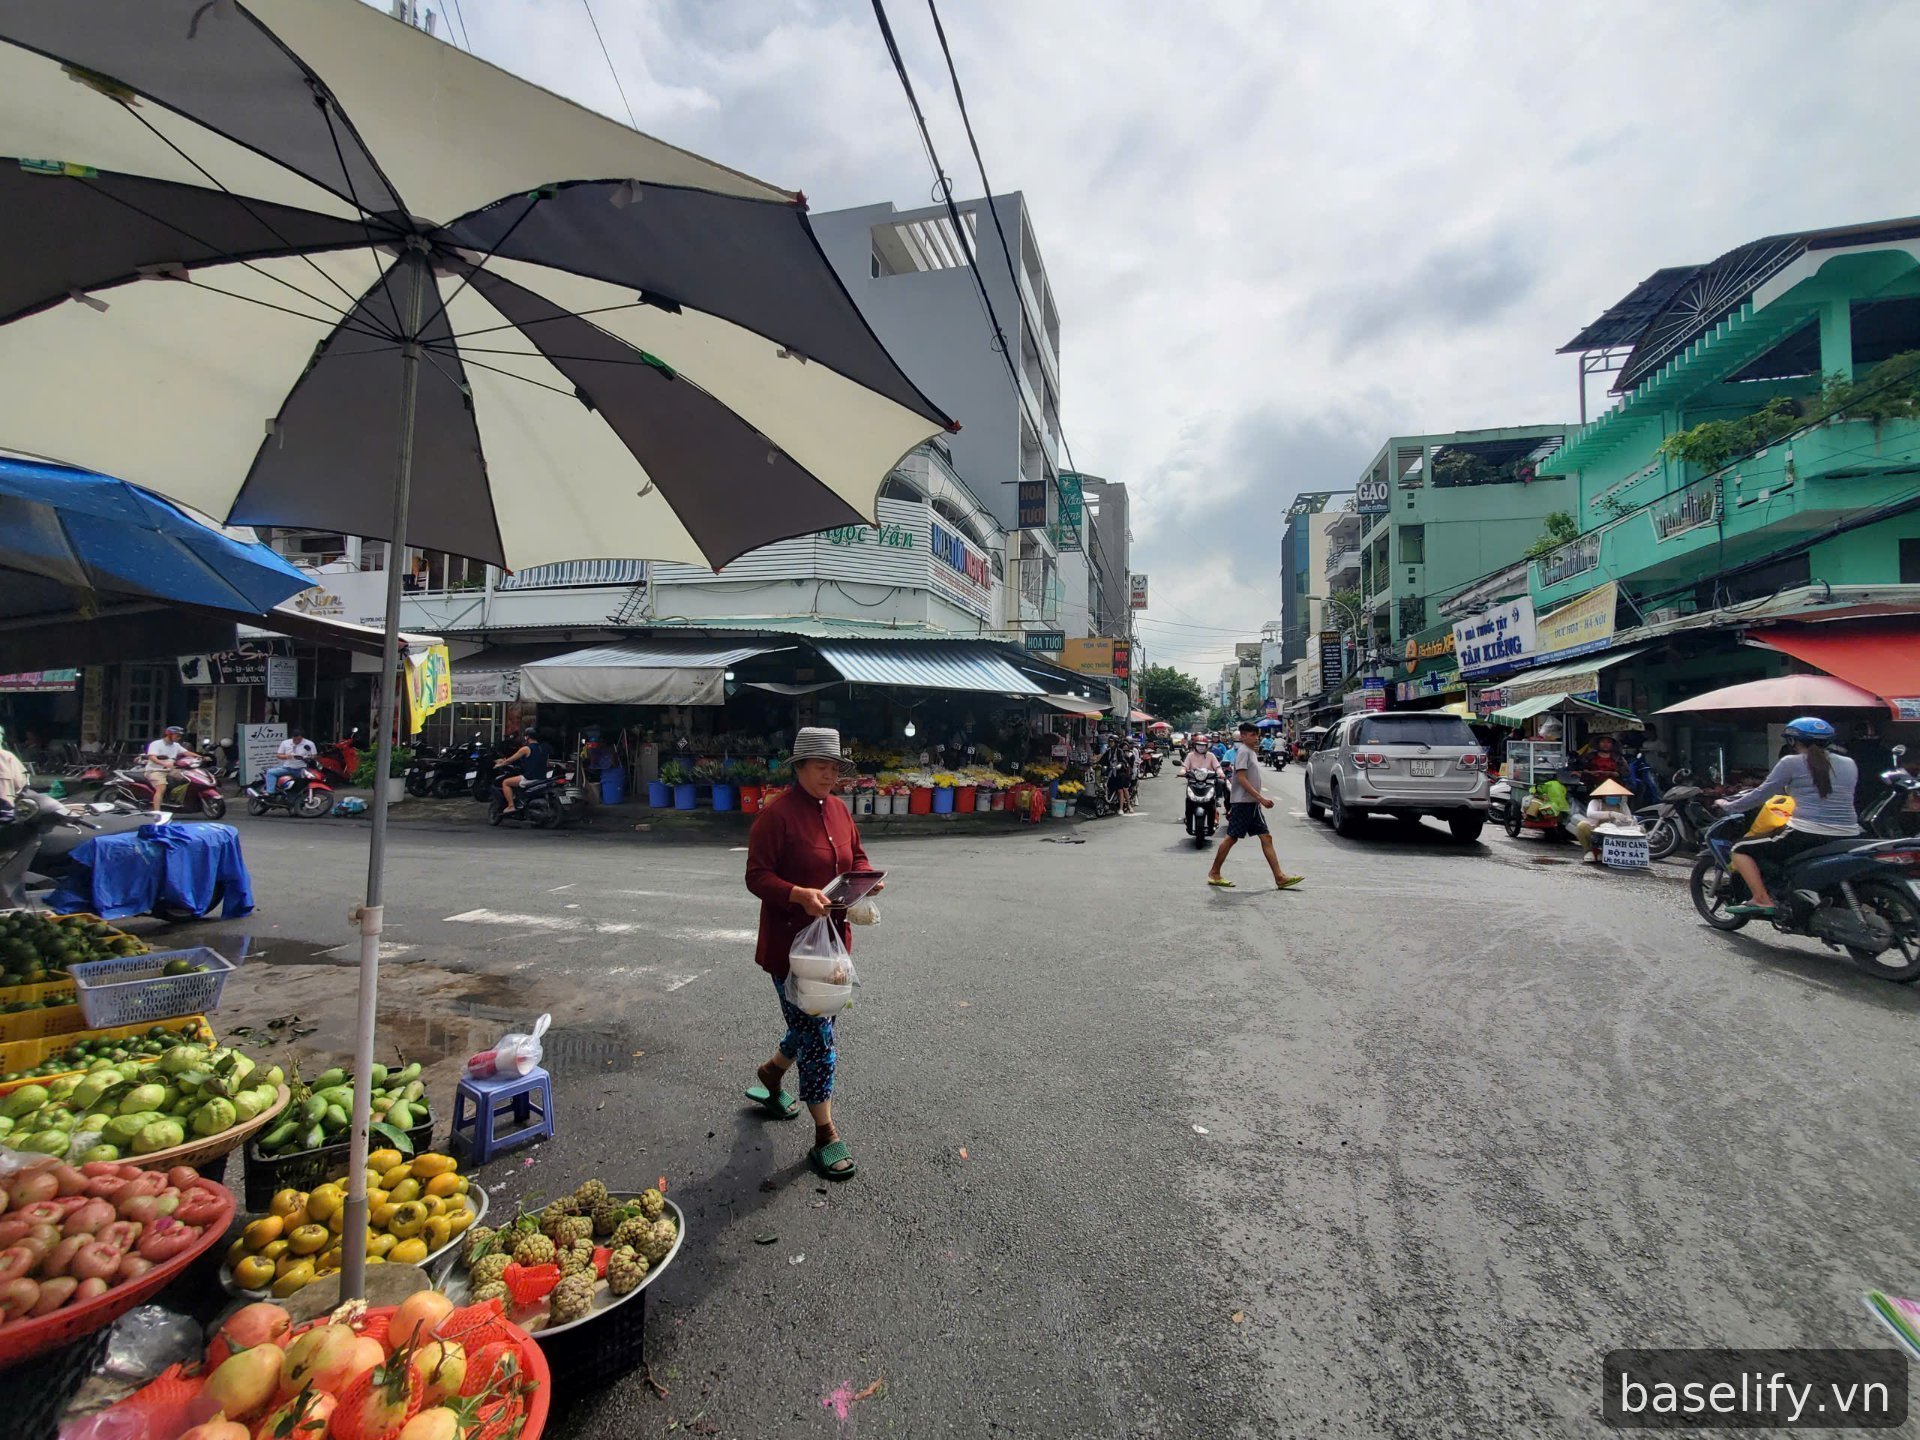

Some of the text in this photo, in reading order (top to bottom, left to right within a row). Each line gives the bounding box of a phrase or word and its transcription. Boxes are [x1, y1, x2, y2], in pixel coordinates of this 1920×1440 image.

[1021, 485, 1044, 500] HOA
[1358, 483, 1388, 505] GẠO
[878, 524, 914, 547] Vân
[1027, 635, 1062, 650] HOA TƯƠI
[1460, 645, 1481, 667] TÂN
[1085, 771, 1095, 783] 15
